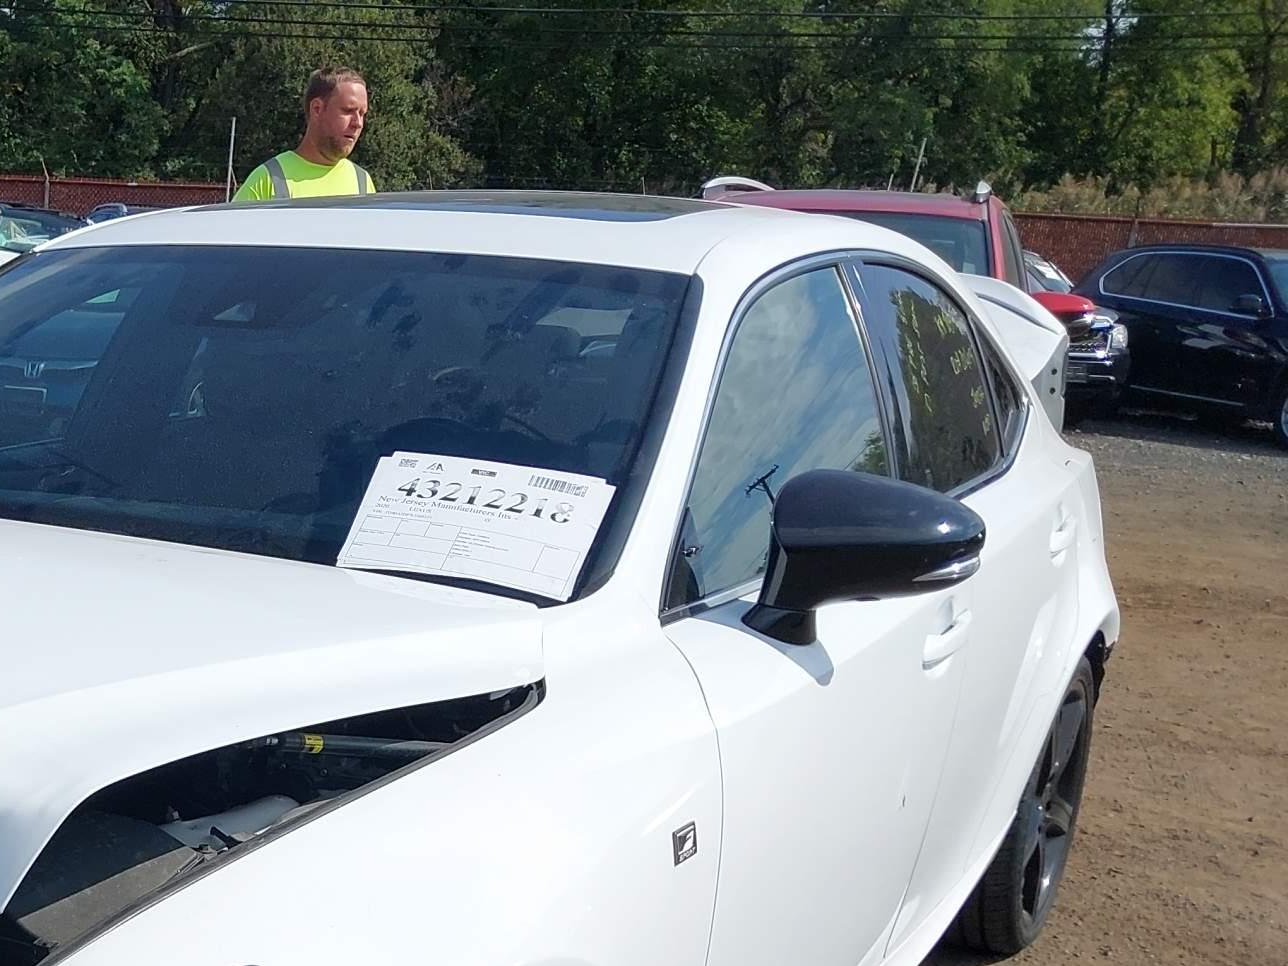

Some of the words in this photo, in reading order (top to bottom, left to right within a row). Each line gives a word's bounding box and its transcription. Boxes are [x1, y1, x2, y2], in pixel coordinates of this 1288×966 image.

[378, 495, 399, 503] New
[401, 498, 429, 508] Jersey
[398, 478, 575, 523] 43212218
